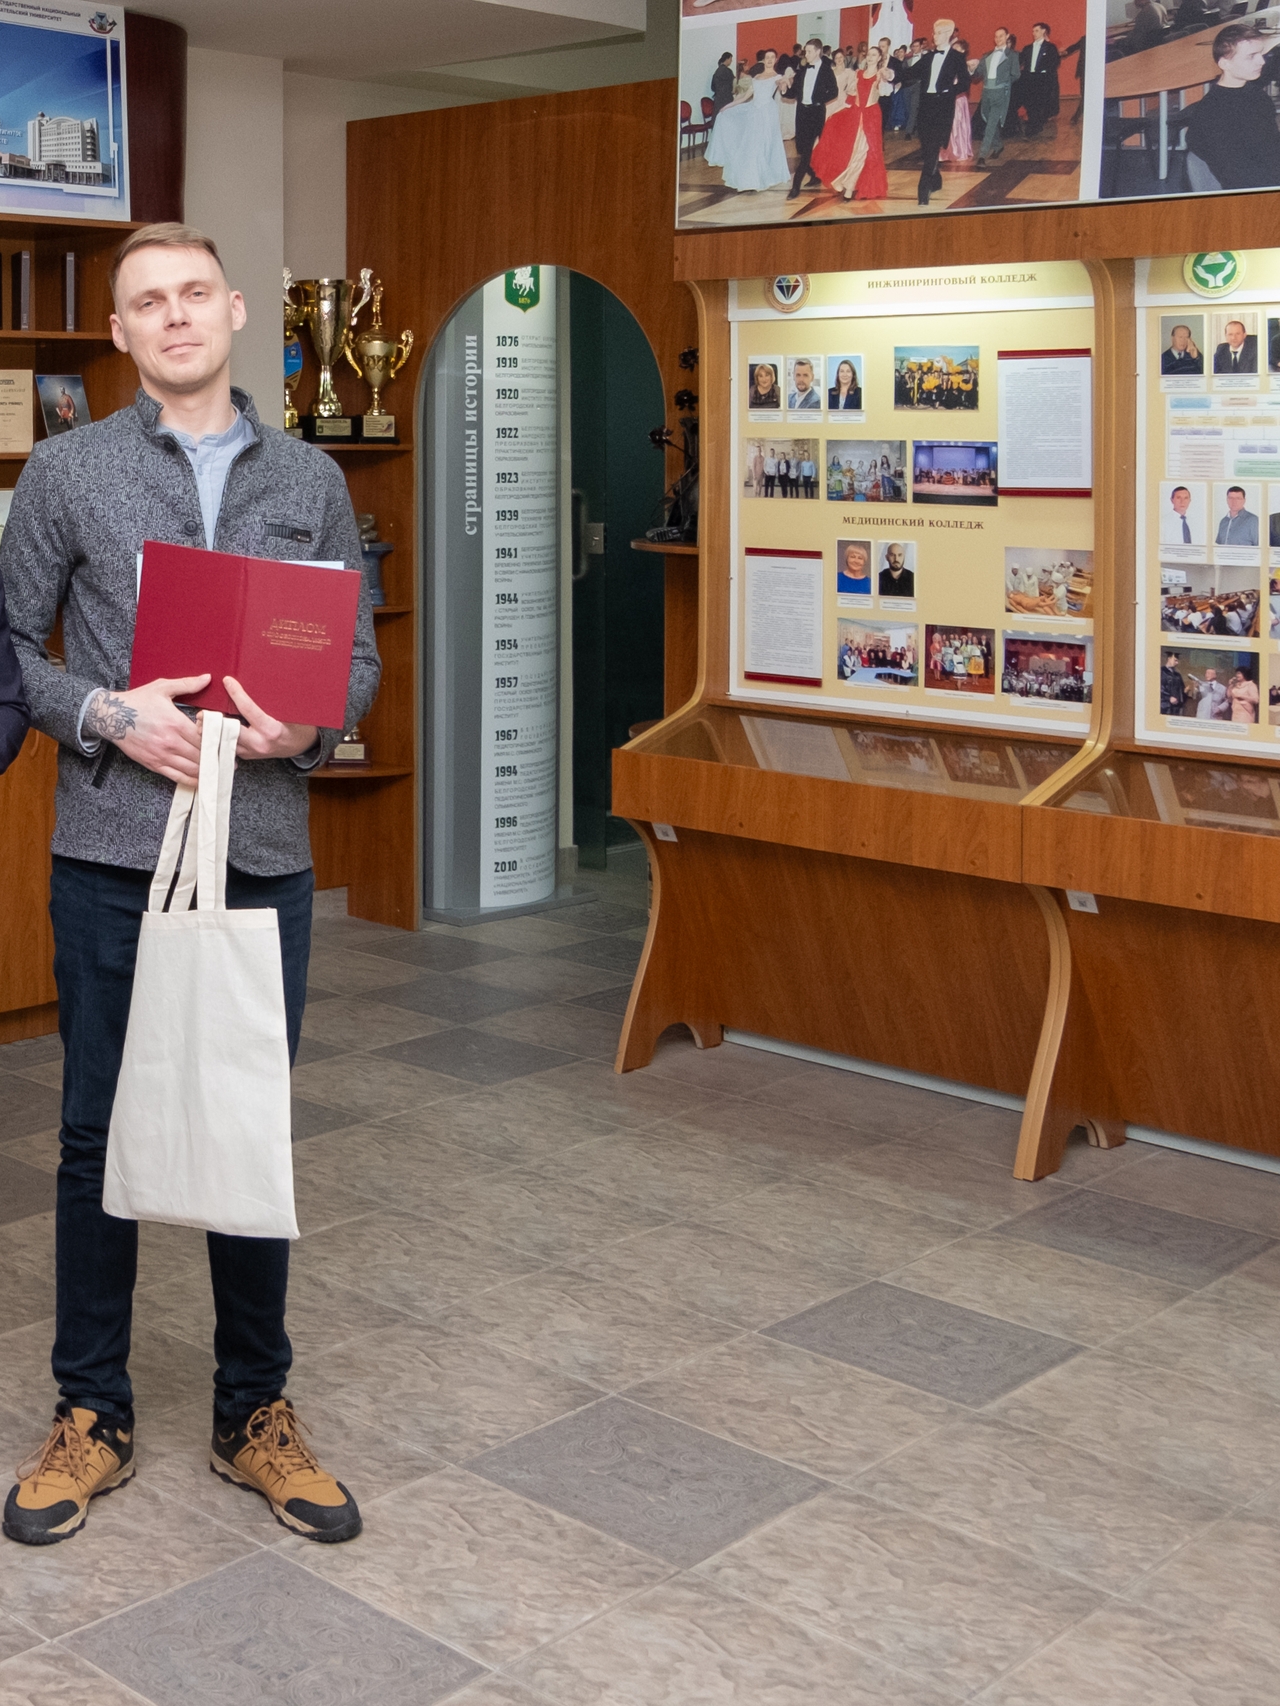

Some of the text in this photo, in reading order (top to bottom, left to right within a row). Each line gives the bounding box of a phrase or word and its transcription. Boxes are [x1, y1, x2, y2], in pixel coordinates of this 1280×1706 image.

[867, 273, 1038, 289] ИНЖИНИРИНГОВЫЙ КОЛЛЕДЖ
[495, 335, 519, 347] 1876
[495, 357, 518, 368] 1919
[495, 388, 519, 400] 1920
[465, 335, 482, 536] страницы истории
[495, 427, 519, 439] 1922
[495, 472, 519, 484] 1923
[495, 509, 519, 521] 1939
[842, 516, 984, 530] МЕДИЦИНСКИЙ КОЛЛЕДЖ
[495, 547, 518, 559] 1941
[495, 593, 519, 605] 1944
[270, 618, 326, 635] ДИПЛОМ
[495, 638, 519, 651] 1954
[495, 676, 519, 688] 1957
[495, 728, 518, 741] 1967
[494, 765, 518, 777] 1994
[494, 815, 518, 828] 1996
[494, 859, 518, 873] 2010
